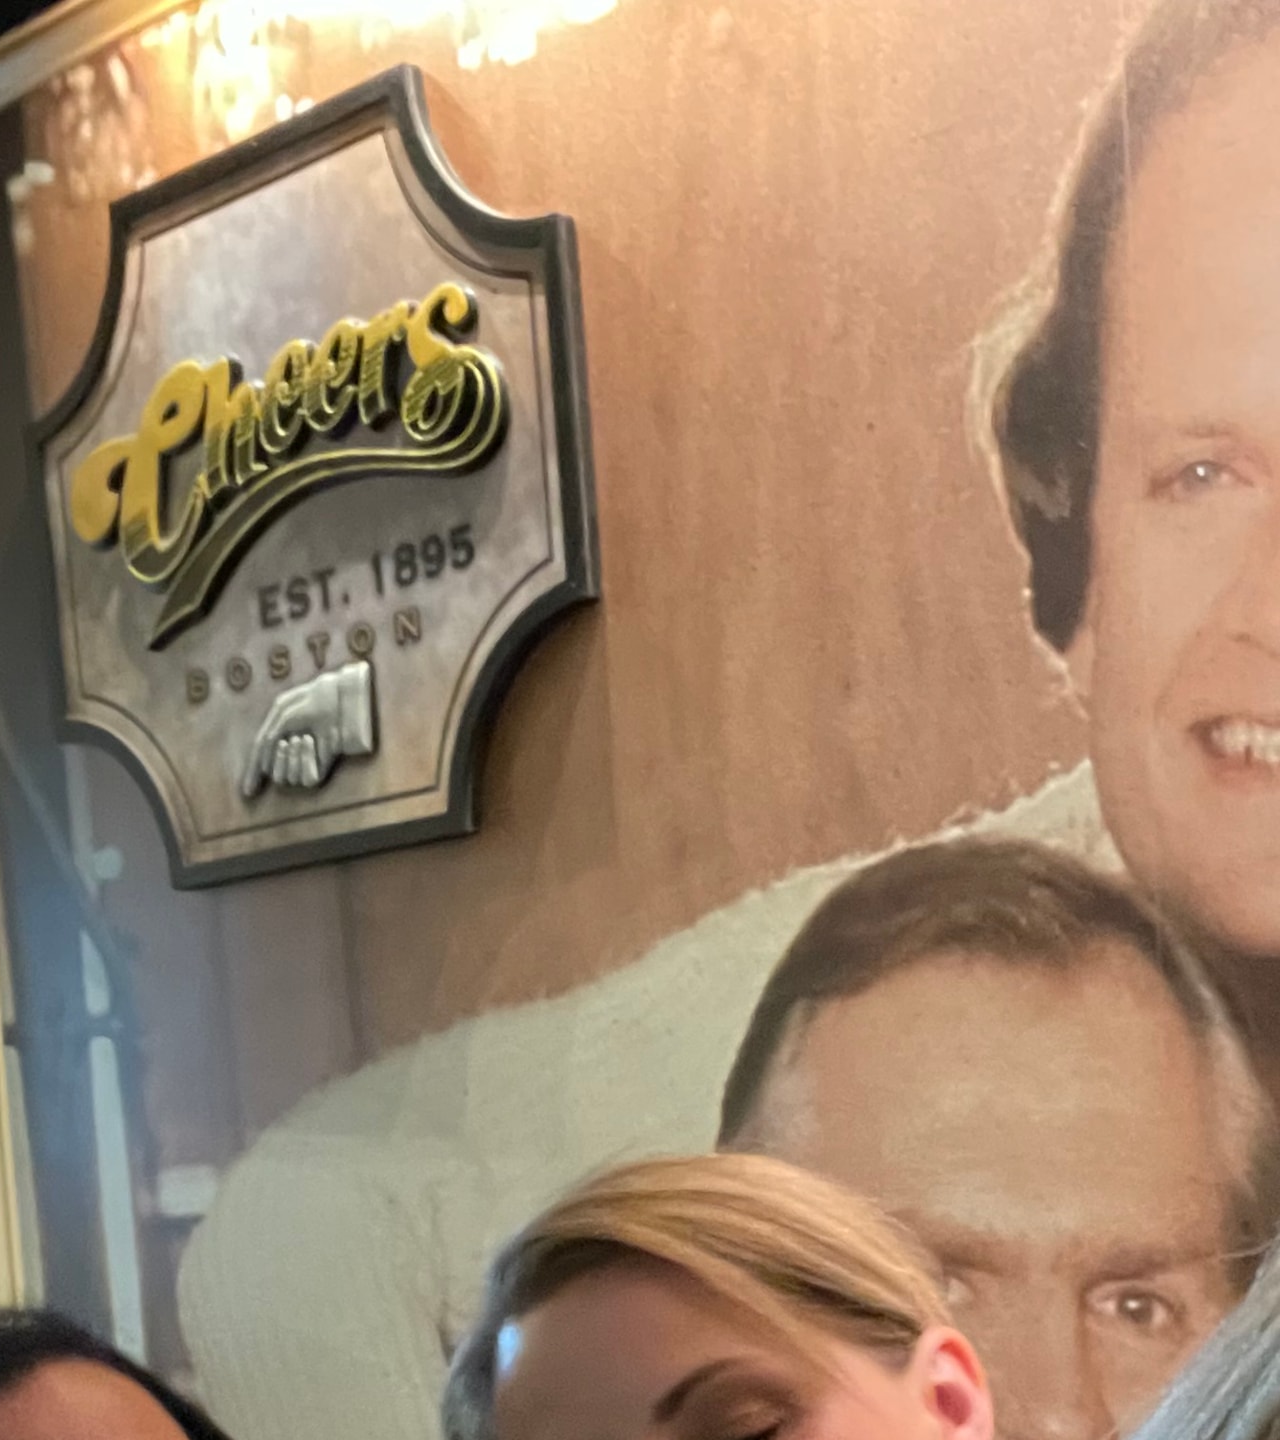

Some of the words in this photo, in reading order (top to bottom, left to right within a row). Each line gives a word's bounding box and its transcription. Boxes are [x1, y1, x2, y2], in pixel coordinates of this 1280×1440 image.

[71, 281, 508, 640] Cheers
[258, 564, 349, 629] EST.
[371, 524, 475, 596] 1895
[186, 606, 422, 705] BOSTON
